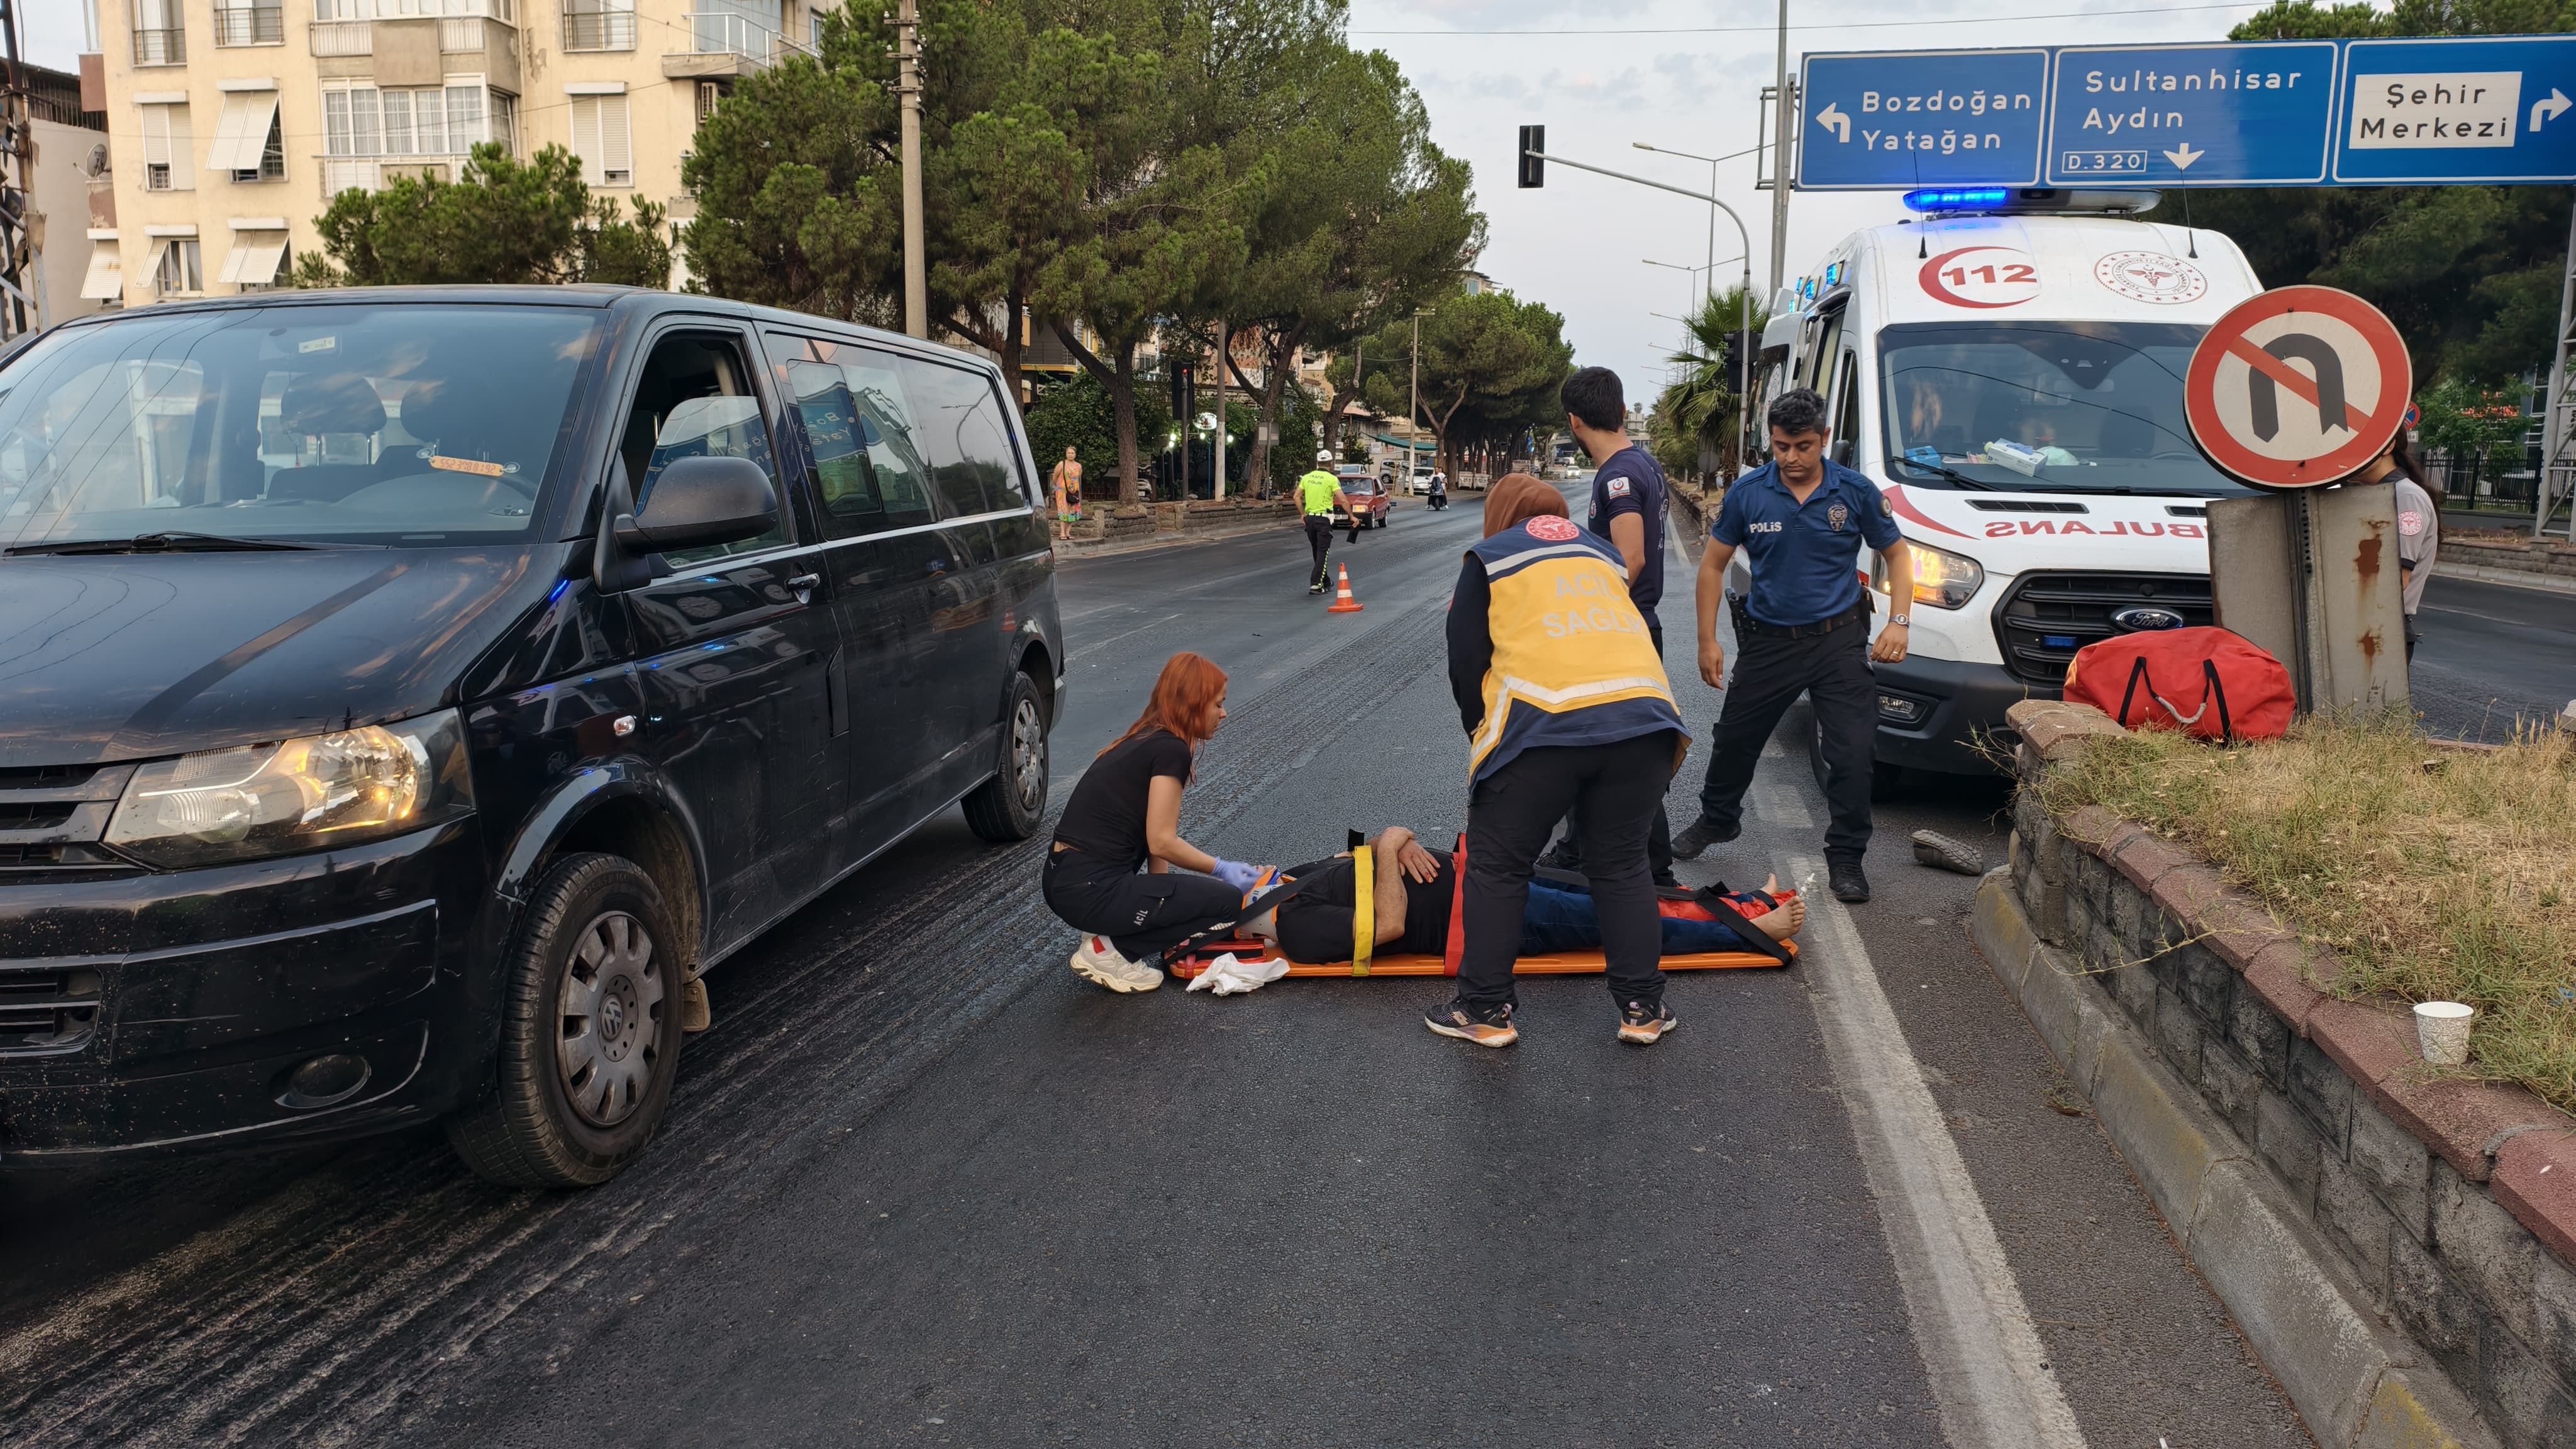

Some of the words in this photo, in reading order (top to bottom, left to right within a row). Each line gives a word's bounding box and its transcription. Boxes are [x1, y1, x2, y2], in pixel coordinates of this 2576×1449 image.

[2085, 68, 2302, 94] Sultanhisar
[1862, 89, 2031, 116] Bozdoğan
[2386, 82, 2487, 109] Şehir
[2082, 106, 2184, 135] Aydın
[2359, 116, 2507, 140] Merkezi
[1862, 129, 2001, 155] Yatağan
[2067, 154, 2141, 170] D.320
[1941, 264, 2038, 286] 112
[2132, 612, 2169, 627] Ford
